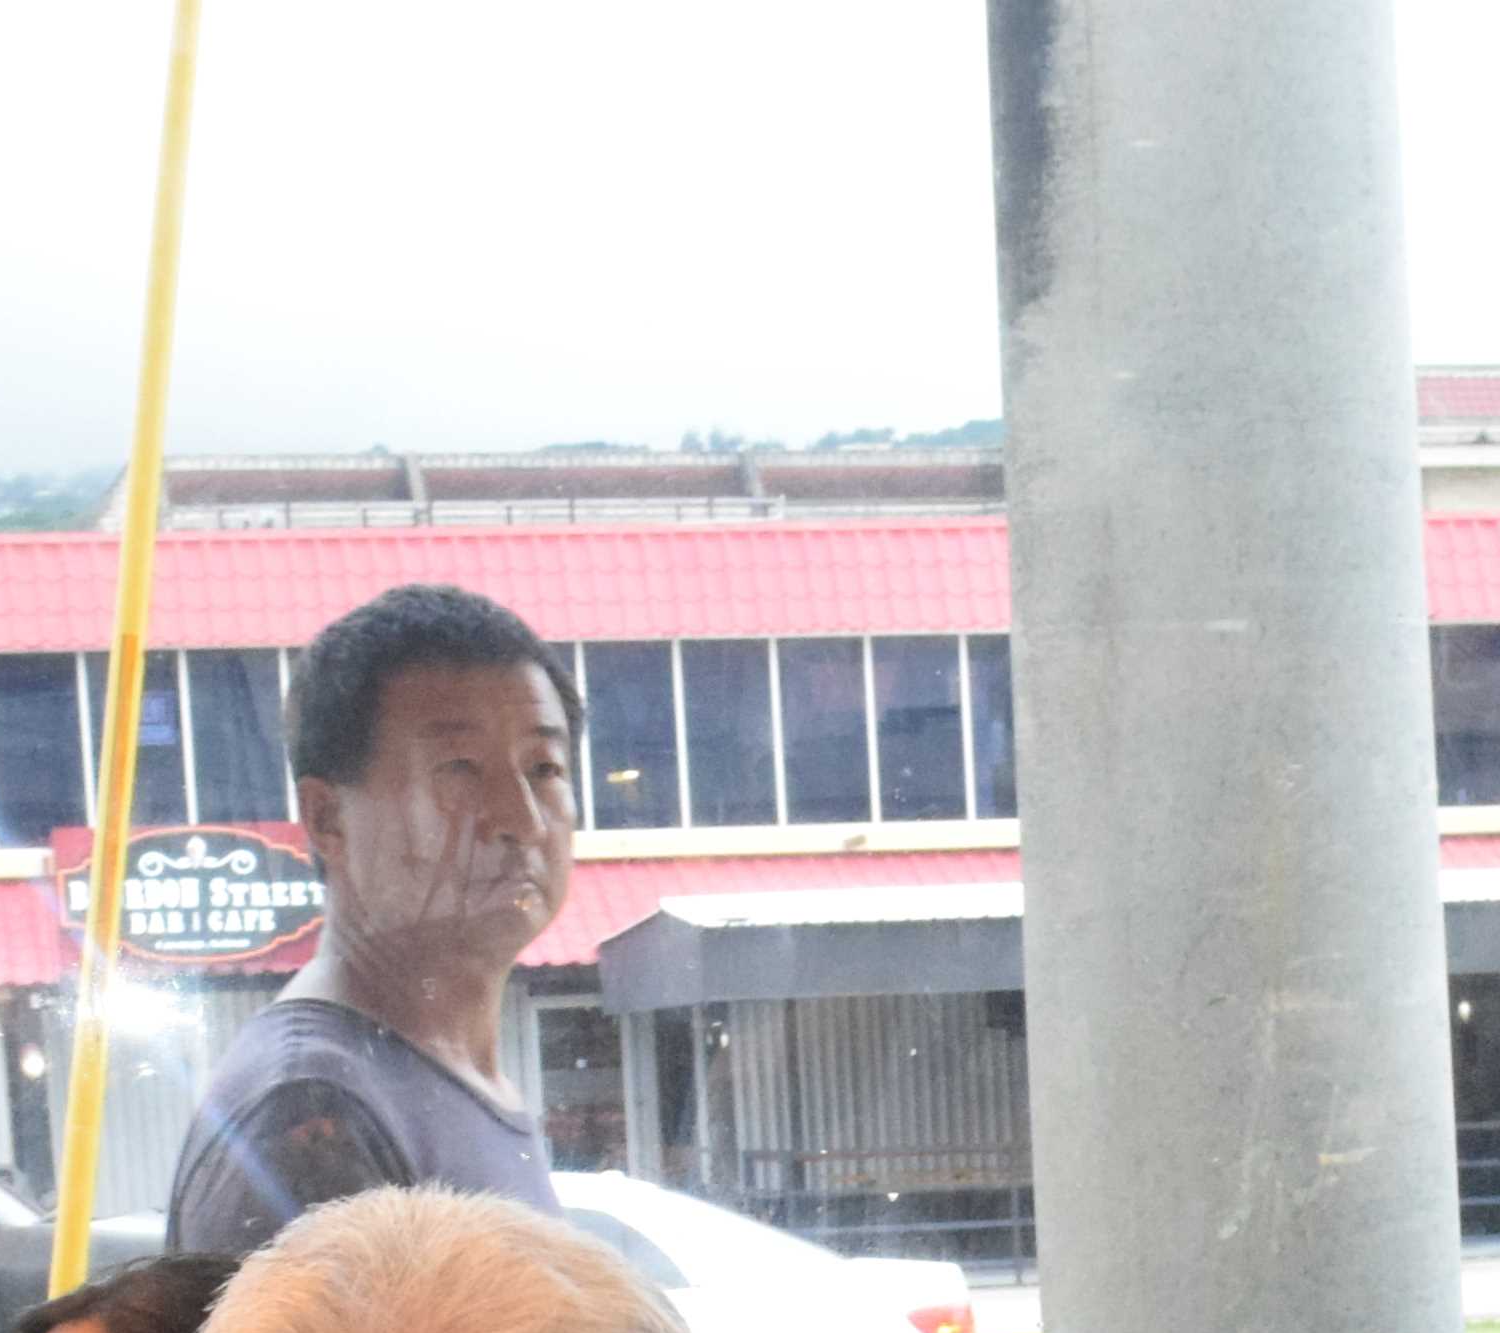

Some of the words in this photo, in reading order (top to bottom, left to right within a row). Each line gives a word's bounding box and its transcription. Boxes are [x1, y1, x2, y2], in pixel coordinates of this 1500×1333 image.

[69, 877, 200, 911] BRBON
[130, 911, 184, 935] BAR
[208, 909, 276, 932] CAFE
